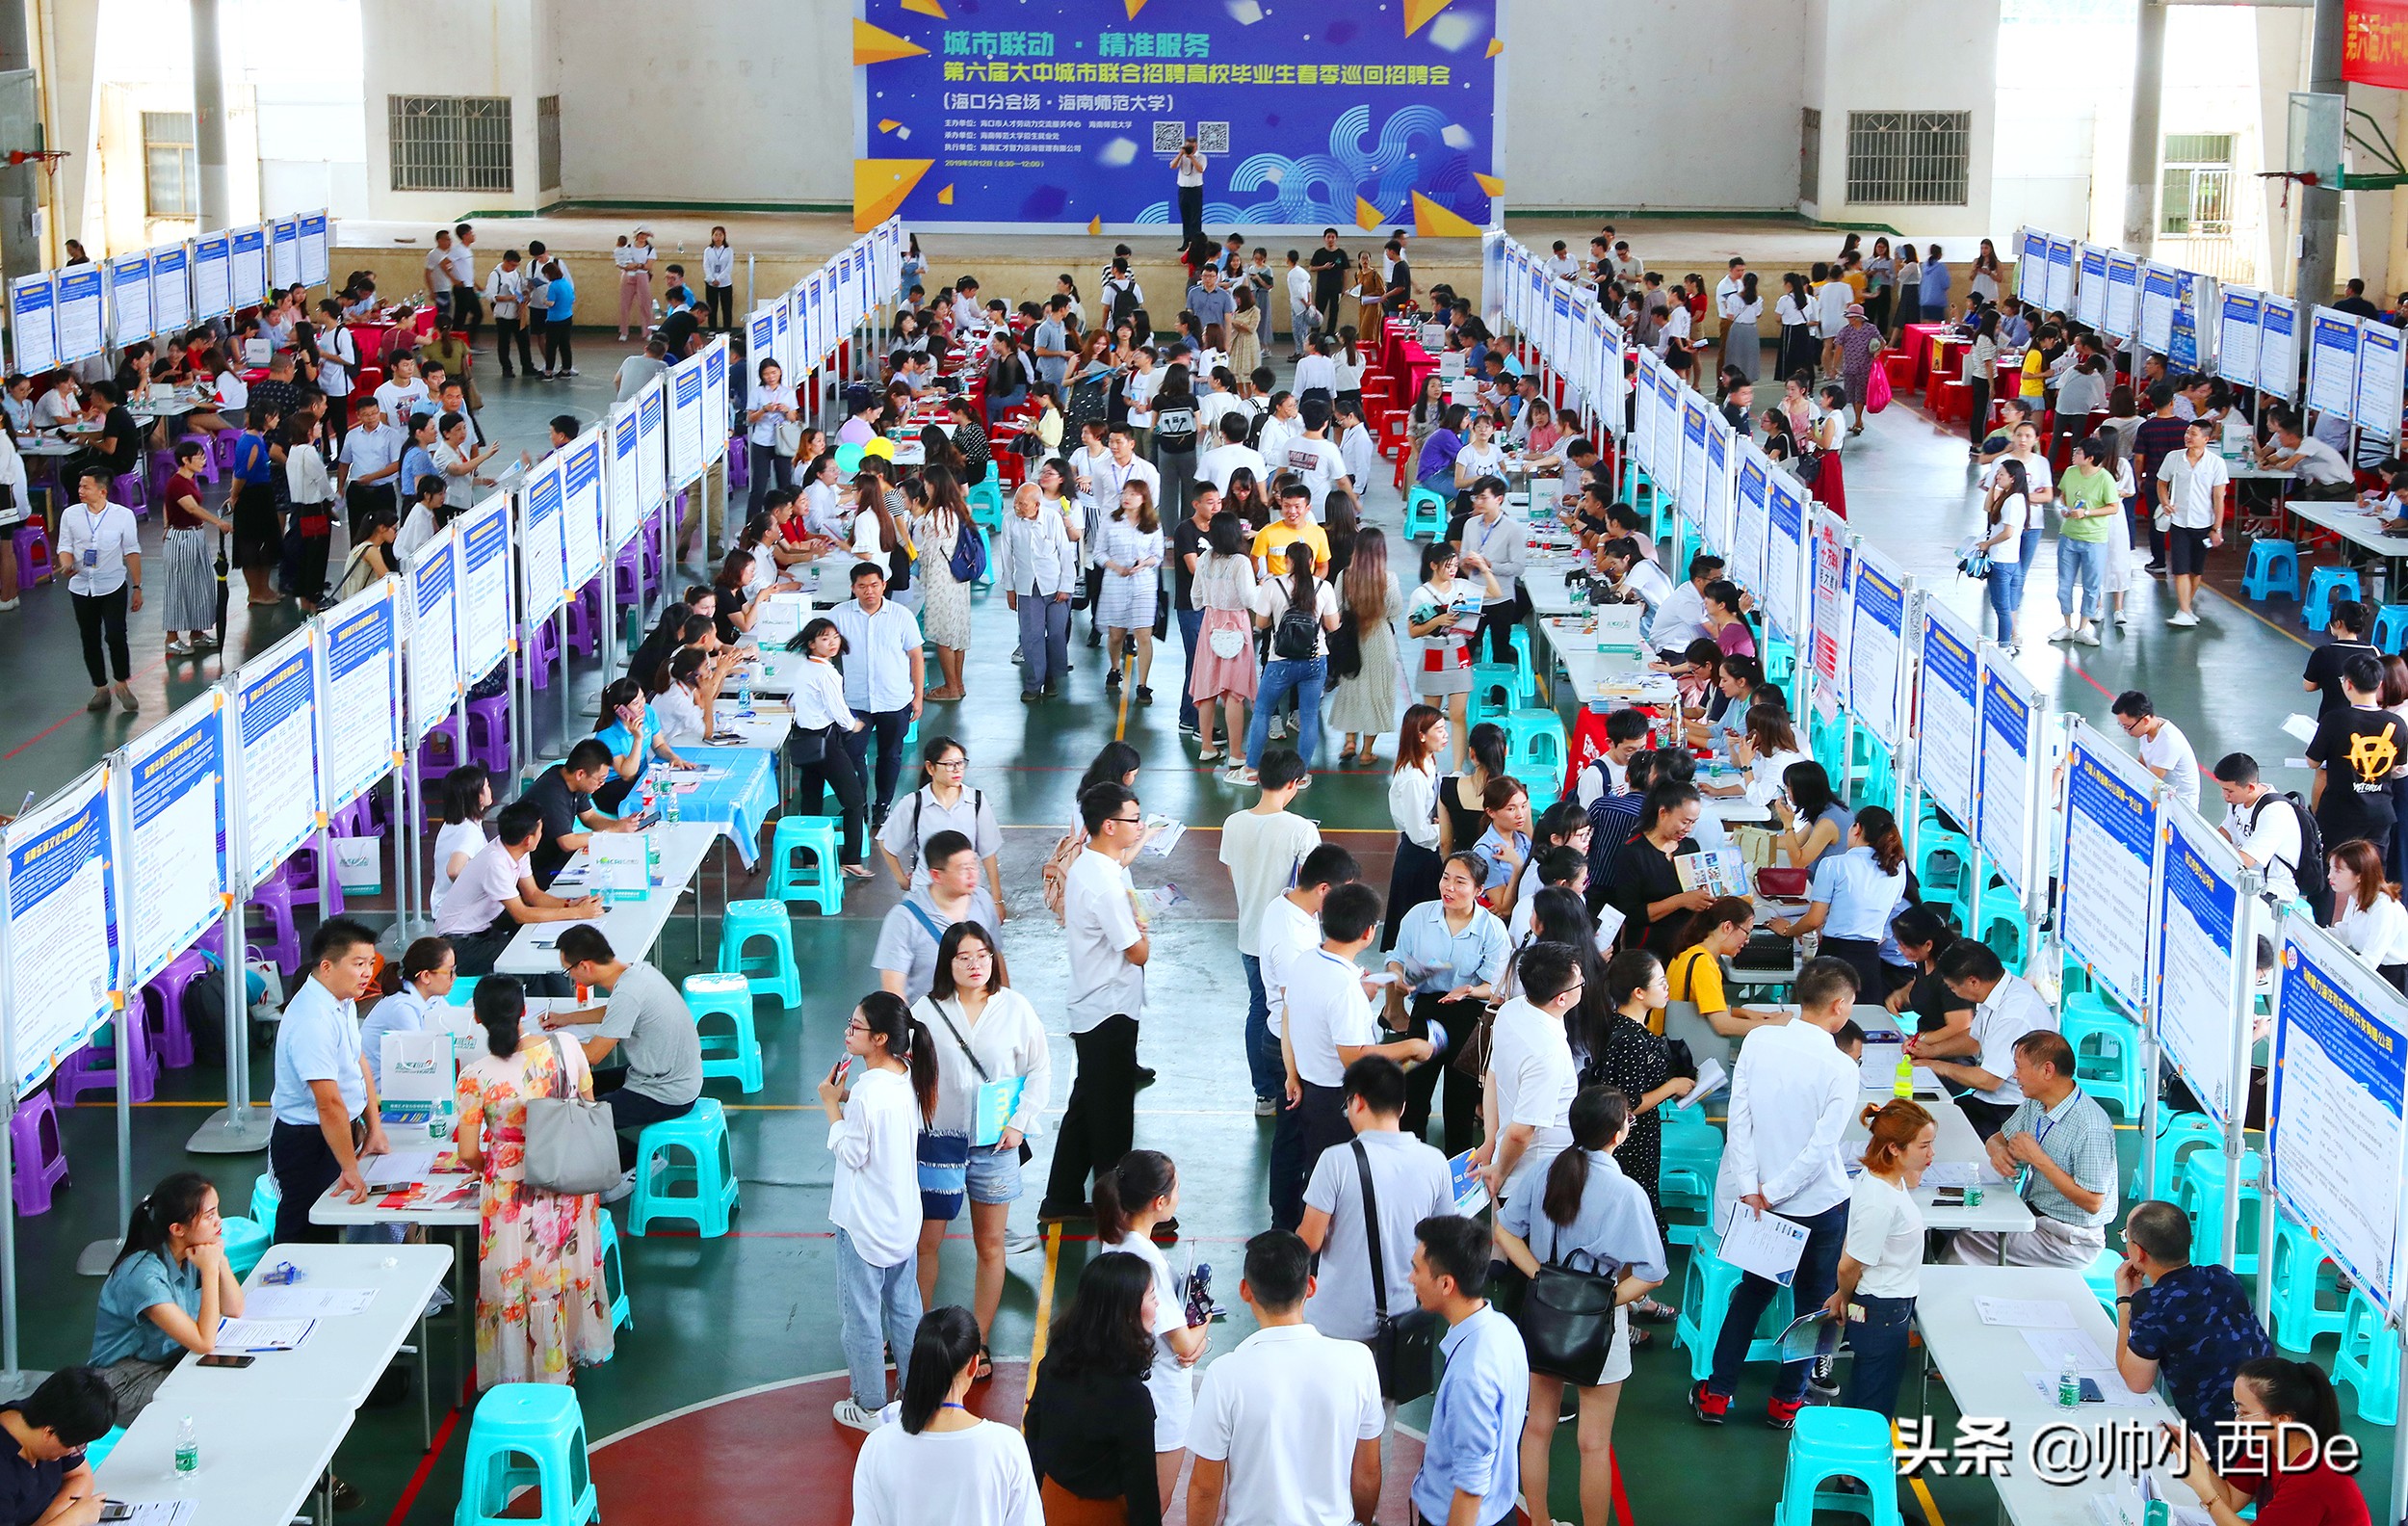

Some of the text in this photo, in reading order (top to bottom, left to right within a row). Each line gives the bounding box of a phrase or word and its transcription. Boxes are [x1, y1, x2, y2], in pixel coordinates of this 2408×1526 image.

[943, 30, 1055, 57] 城市联动
[1098, 32, 1210, 58] 精准服务
[943, 61, 1451, 86] 第六届大中城市联合招聘高校毕业生春季巡回招聘会
